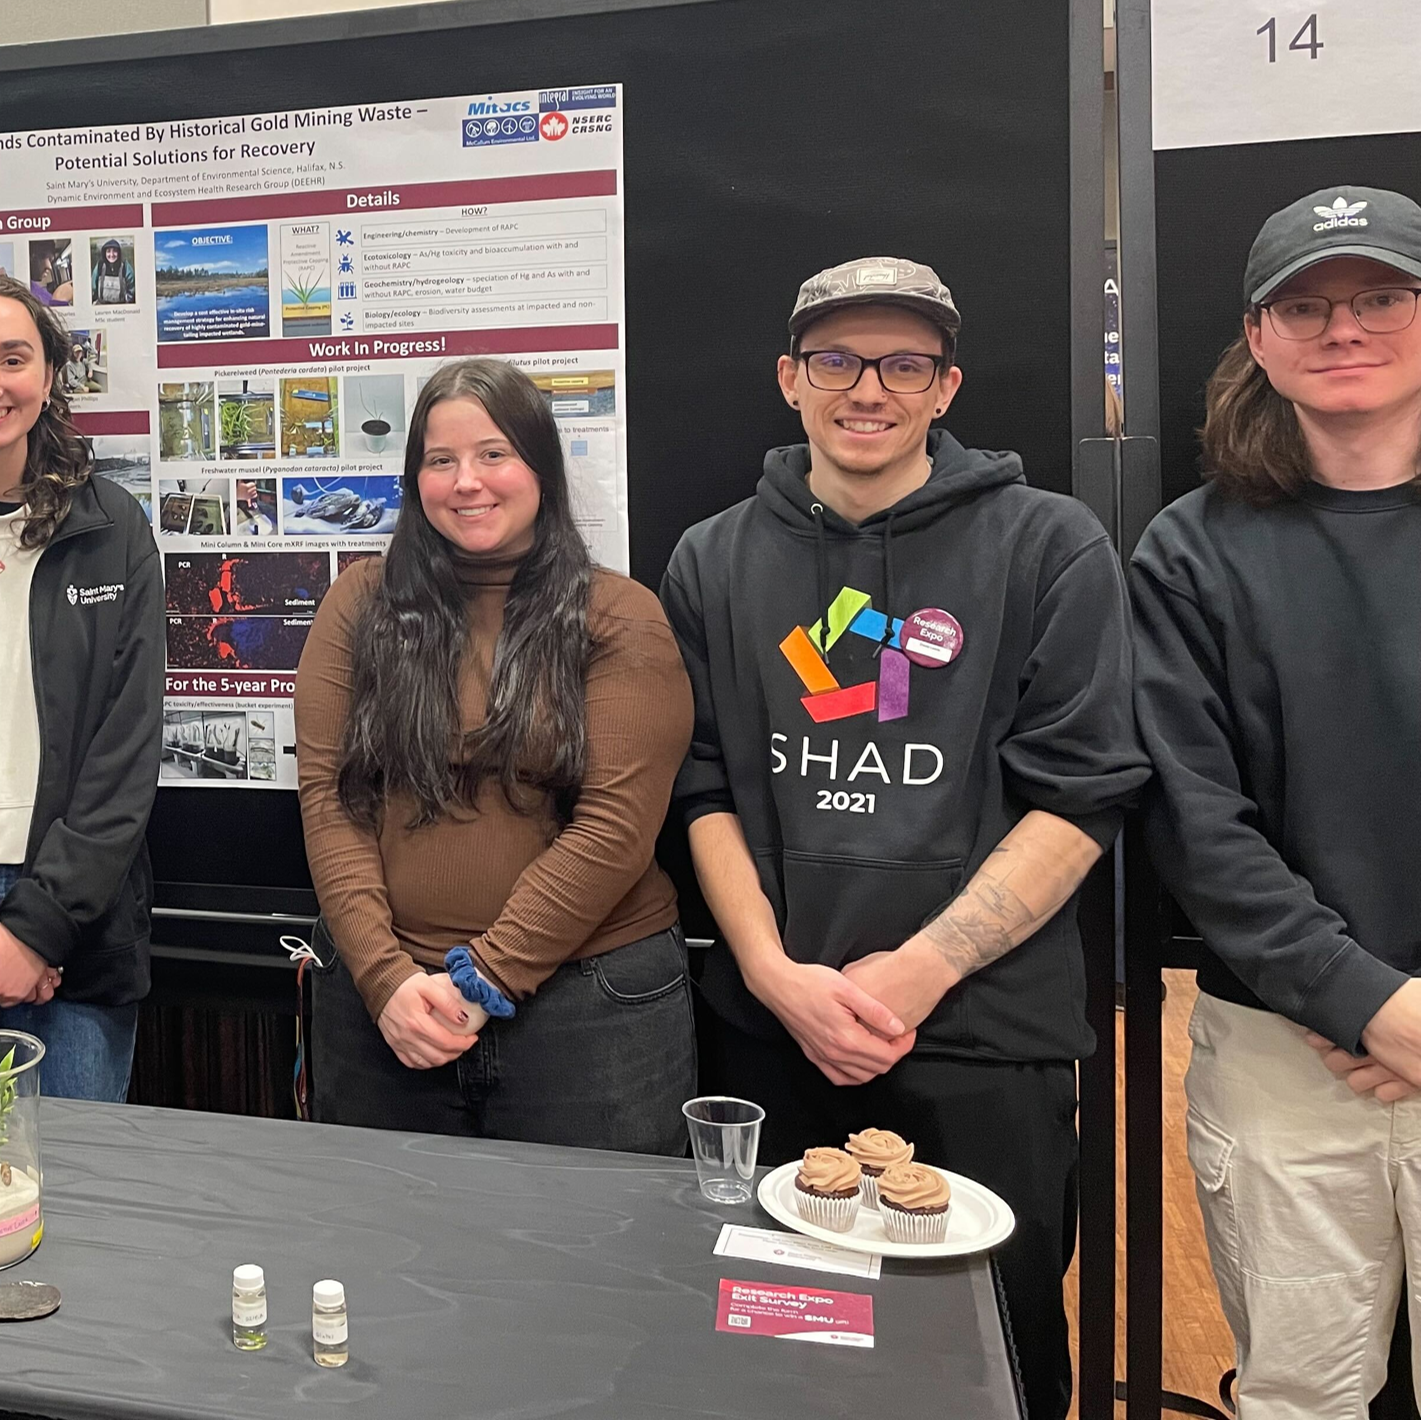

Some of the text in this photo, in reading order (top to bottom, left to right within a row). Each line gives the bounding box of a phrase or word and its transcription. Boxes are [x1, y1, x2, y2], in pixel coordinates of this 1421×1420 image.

[1257, 13, 1324, 63] 14
[468, 96, 531, 116] Mitacs
[27, 126, 140, 146] Contaminated
[146, 126, 165, 143] By
[170, 118, 245, 138] Historical
[251, 113, 288, 131] Gold
[295, 110, 352, 128] Mining
[358, 106, 411, 122] Waste
[572, 114, 612, 124] NSERC
[572, 124, 612, 134] CRSNG
[56, 141, 315, 170] Potential Solutions for Recovery
[347, 191, 399, 207] Details
[461, 206, 488, 216] HOW?
[7, 216, 50, 230] Group
[291, 225, 320, 234] WHAT?
[1313, 217, 1368, 231] adidas
[192, 235, 233, 244] OBJECTIVE:
[309, 337, 445, 356] Work In Progress!
[259, 368, 297, 376] (Pontederia
[79, 583, 124, 597] Saint Mary's
[80, 592, 118, 605] University
[913, 616, 957, 637] Research
[919, 628, 943, 642] Expo
[166, 678, 189, 690] For
[192, 677, 216, 691] the
[221, 678, 266, 694] 5-year
[771, 733, 943, 785] SHAD
[817, 790, 875, 813] 2021
[732, 1286, 834, 1304] Research Expo
[732, 1293, 807, 1309] Exit Survey
[805, 1315, 833, 1324] SMU
